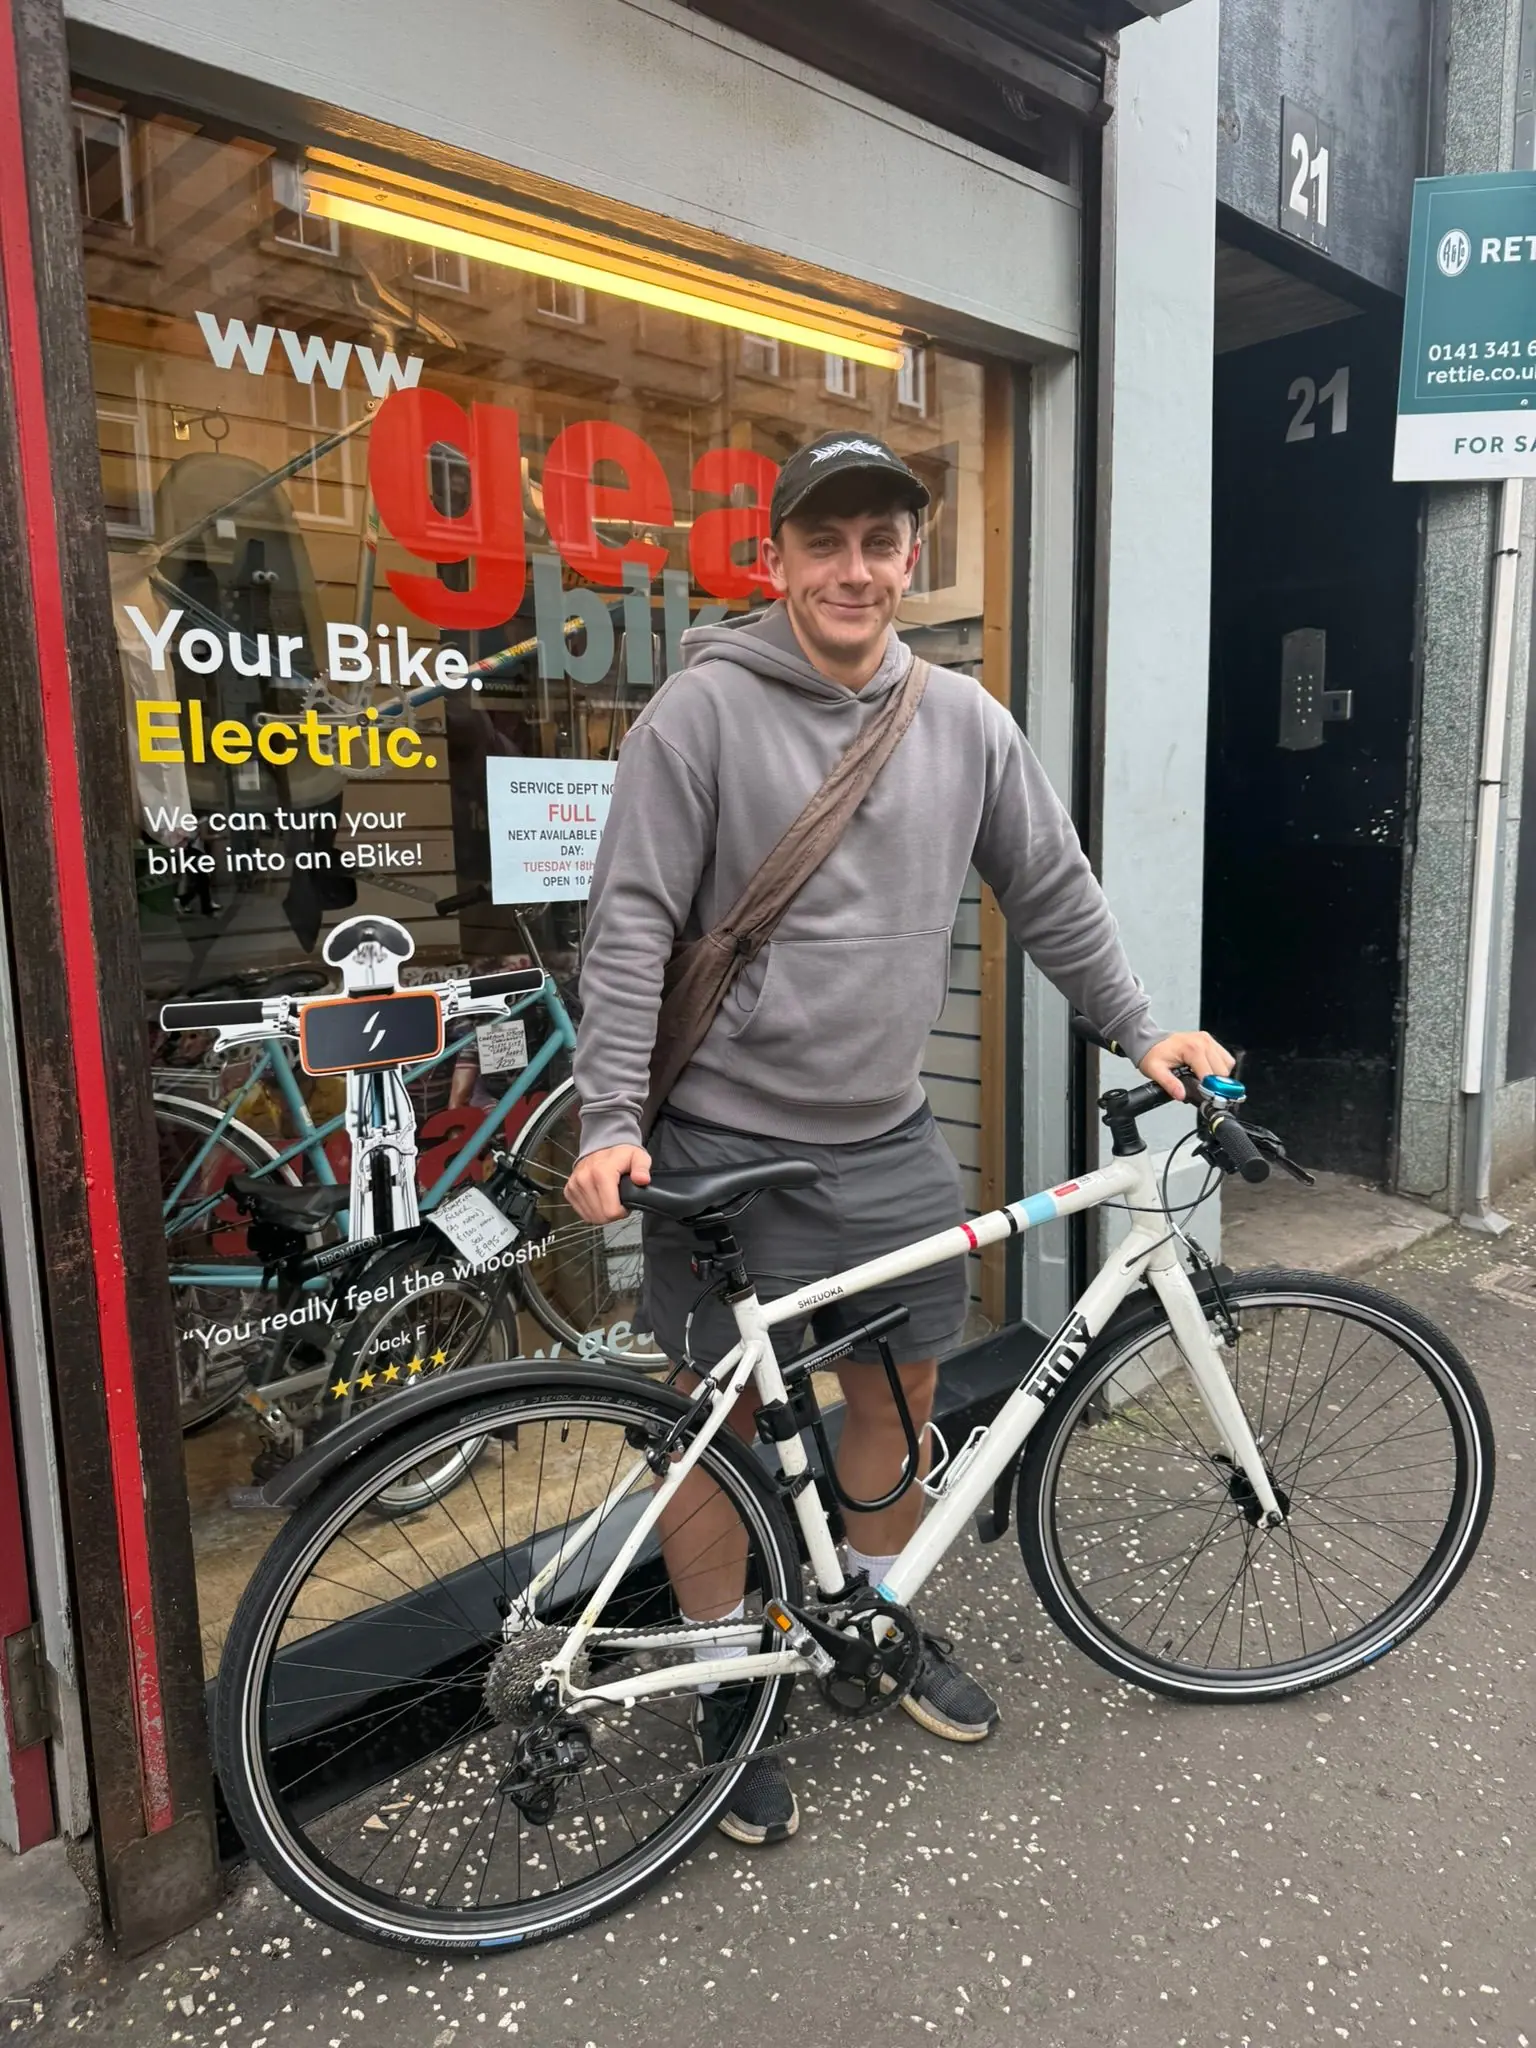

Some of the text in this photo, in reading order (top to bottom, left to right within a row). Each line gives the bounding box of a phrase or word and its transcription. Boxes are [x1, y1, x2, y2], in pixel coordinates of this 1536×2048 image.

[1289, 132, 1329, 227] 21
[1480, 236, 1536, 264] RET
[1428, 339, 1536, 362] 0141 341 6
[1285, 366, 1350, 443] 21
[1454, 436, 1504, 455] FOR
[124, 606, 303, 678] Your
[325, 622, 483, 692] Bike.
[136, 700, 437, 768] Electric.
[510, 781, 564, 795] SERVICE
[567, 782, 598, 795] DEPT
[144, 806, 406, 837] We can turn your
[548, 804, 596, 822] FULL
[508, 830, 536, 841] NEXT
[540, 830, 597, 841] AVAILABLE
[148, 843, 423, 875] bike into an eBike!
[560, 845, 584, 856] DAY:
[523, 861, 572, 872] TUESDAY
[543, 876, 570, 887] OPEN
[575, 876, 585, 886] 10
[319, 1235, 379, 1267] BROMPTON
[260, 1296, 337, 1335] really
[344, 1276, 395, 1311] feel
[402, 1267, 445, 1293] the
[797, 1284, 844, 1309] SHIZUOKA
[368, 1332, 411, 1356] Jack
[416, 1324, 427, 1341] F
[1025, 1315, 1095, 1408] HOY
[379, 1929, 411, 1944] PLUS
[525, 1911, 592, 1939] SCHWALBE
[415, 1936, 478, 1948] MARATHON
